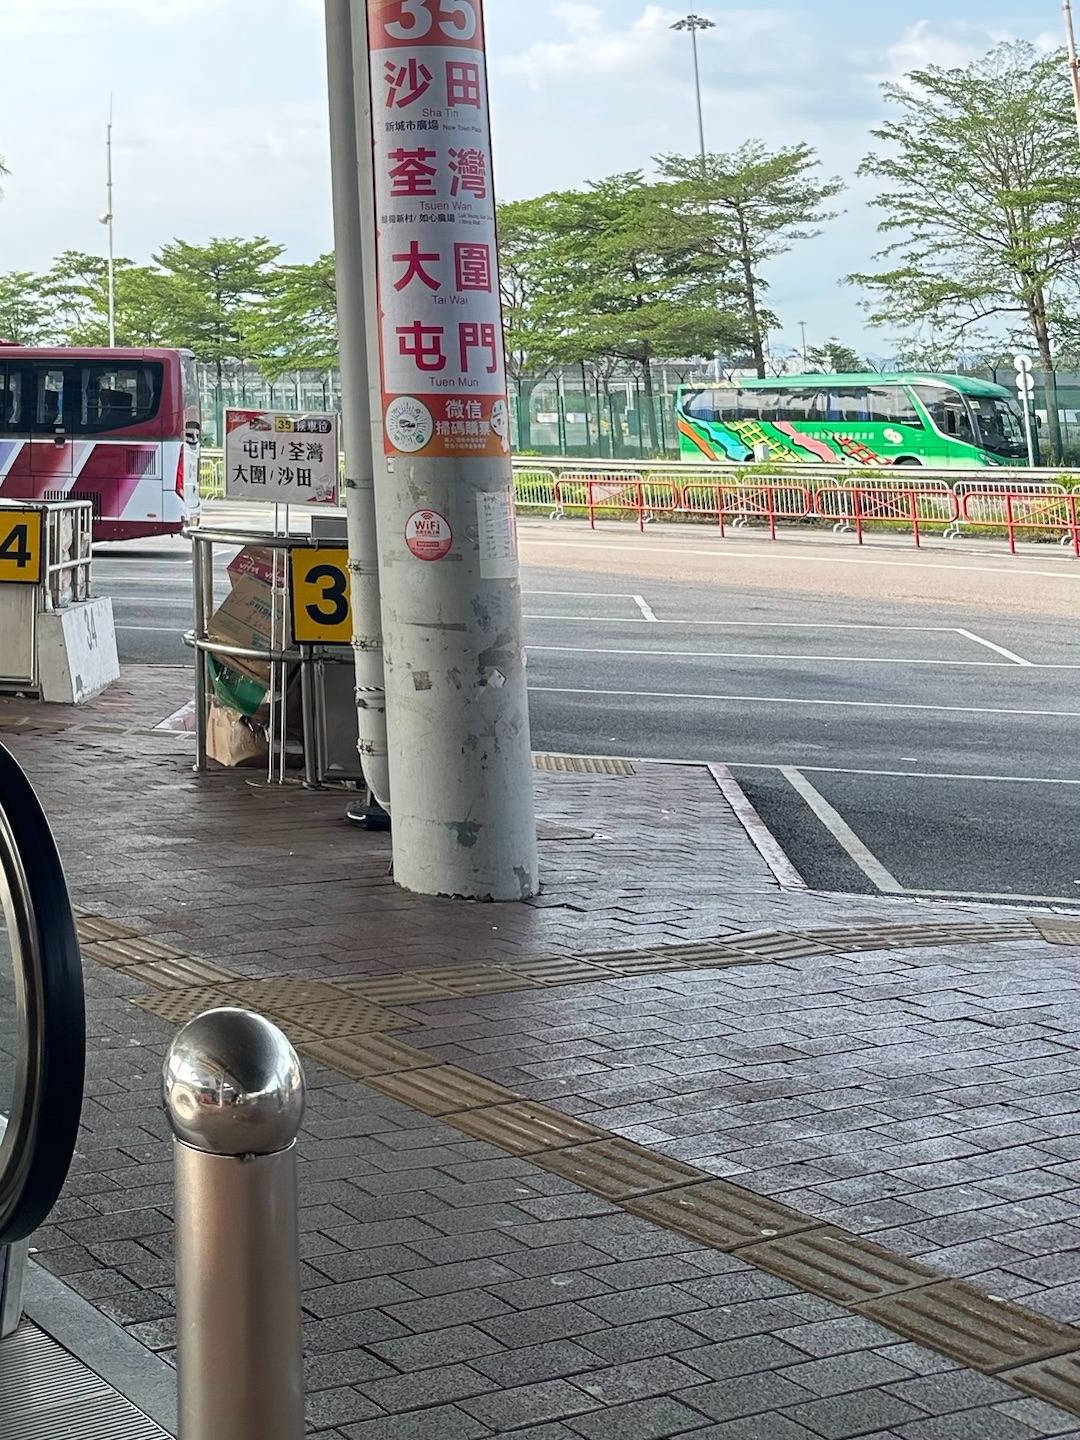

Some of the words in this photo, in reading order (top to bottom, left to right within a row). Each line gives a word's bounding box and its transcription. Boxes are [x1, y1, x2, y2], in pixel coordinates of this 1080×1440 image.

[384, 58, 481, 110] 沙田
[422, 108, 442, 117] Sha
[445, 108, 459, 118] Tin
[387, 147, 487, 200] 荃灣
[419, 201, 449, 211] Tsuen
[452, 201, 472, 211] Wan
[391, 240, 493, 293] 大圍
[432, 295, 448, 305] Tai
[449, 295, 469, 305] Wai
[395, 320, 498, 373] 屯門
[430, 377, 455, 387] Tuen
[458, 377, 479, 387] Mun
[445, 399, 482, 419] 微信
[278, 420, 291, 430] 35
[414, 520, 440, 530] WiFi
[305, 564, 350, 625] 3
